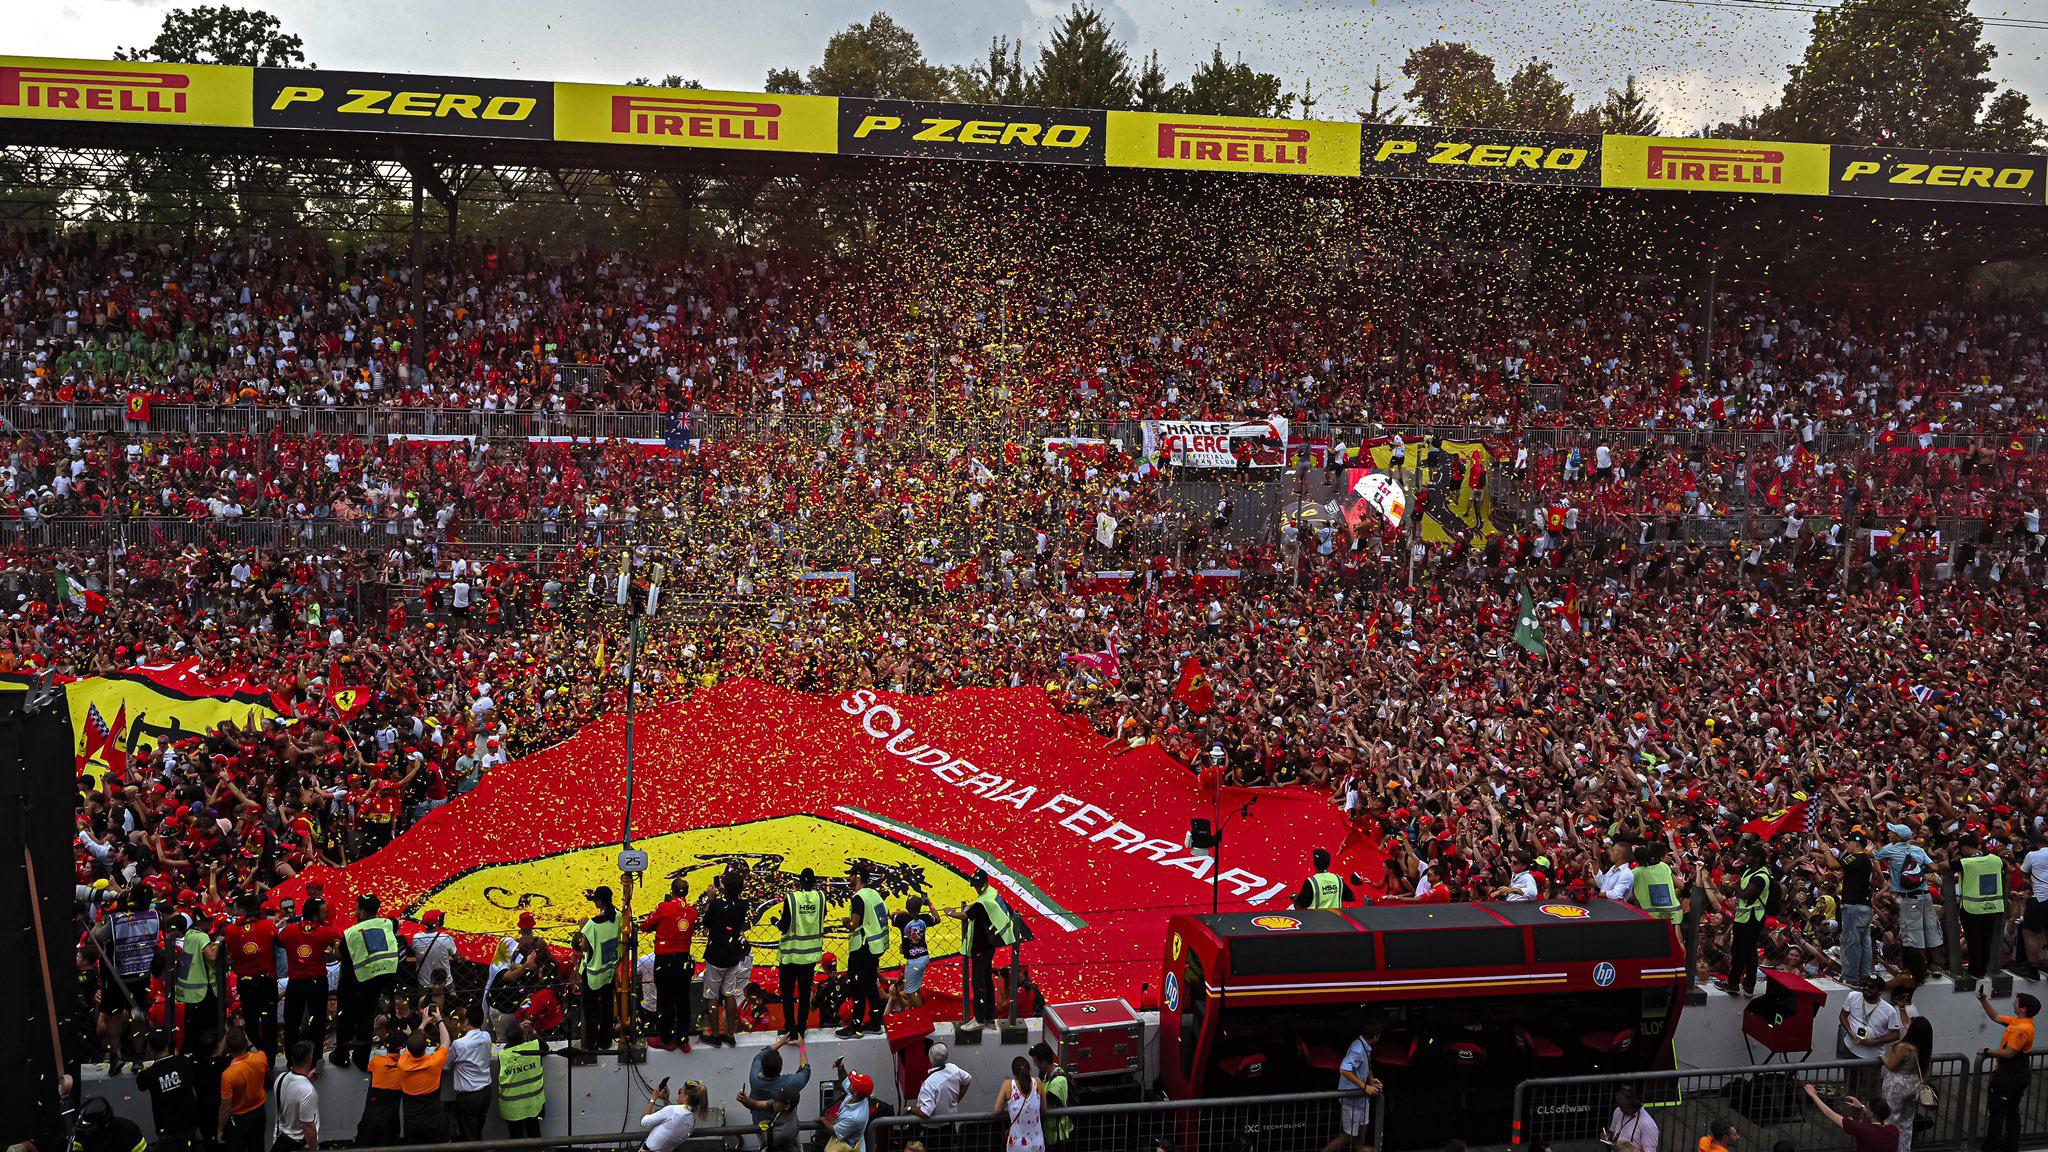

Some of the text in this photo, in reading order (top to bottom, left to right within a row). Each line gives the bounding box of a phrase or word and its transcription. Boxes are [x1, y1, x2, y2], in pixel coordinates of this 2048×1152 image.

[0, 66, 190, 113] PIRELLI
[271, 86, 537, 121] P ZERO
[611, 95, 782, 141] PIRELLI
[853, 115, 1091, 148] P ZERO
[1158, 123, 1311, 164] PIRELLI
[1374, 140, 1588, 170] P ZERO
[1647, 146, 1785, 184] PIRELLI
[1840, 161, 2034, 189] P ZERO
[1164, 423, 1230, 435] HARLES
[1169, 436, 1228, 453] CLERC
[842, 689, 1287, 907] SCUDERIA FERRARI
[625, 857, 641, 867] 25
[1596, 962, 1613, 986] hp
[504, 1062, 536, 1076] WINCH
